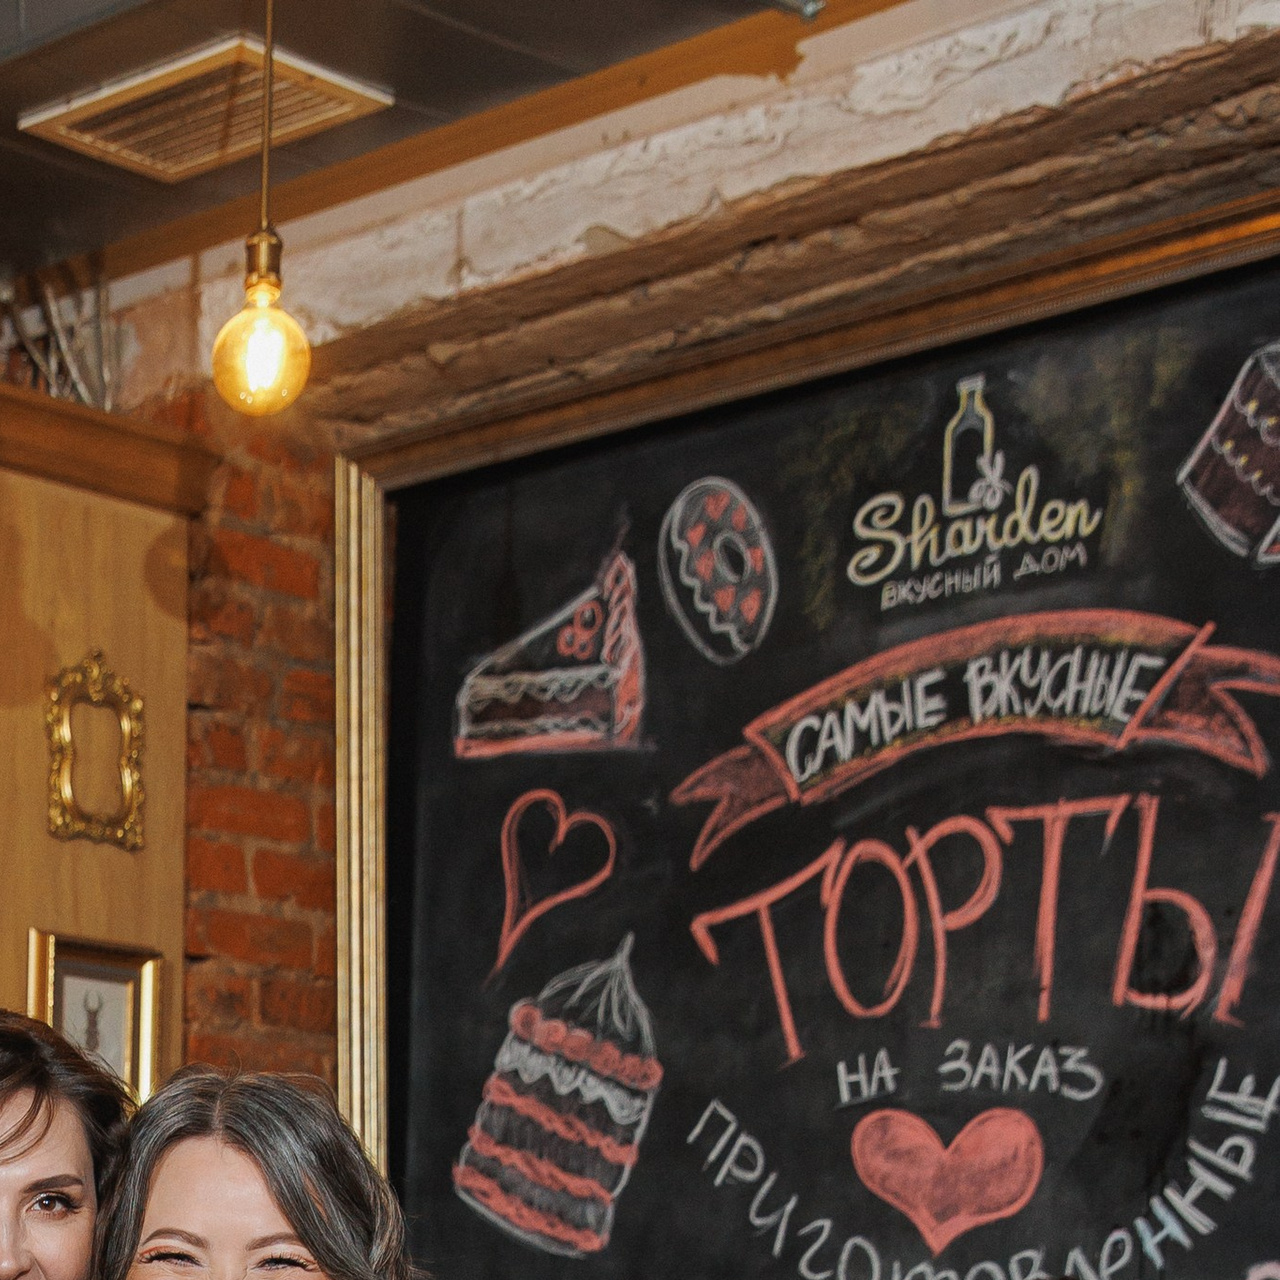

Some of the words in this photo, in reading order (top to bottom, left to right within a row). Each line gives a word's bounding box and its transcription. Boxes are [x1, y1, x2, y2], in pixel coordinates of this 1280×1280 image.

[880, 552, 1002, 611] ВКУСНЫЙ
[1012, 541, 1088, 581] ДОМ
[785, 668, 948, 783] САМЫЕ
[963, 645, 1168, 725] ВКУСНЫЕ
[690, 794, 1280, 1069] ТОРТЫ
[836, 1047, 901, 1102] НА
[937, 1038, 1106, 1101] ЗАКАЗ
